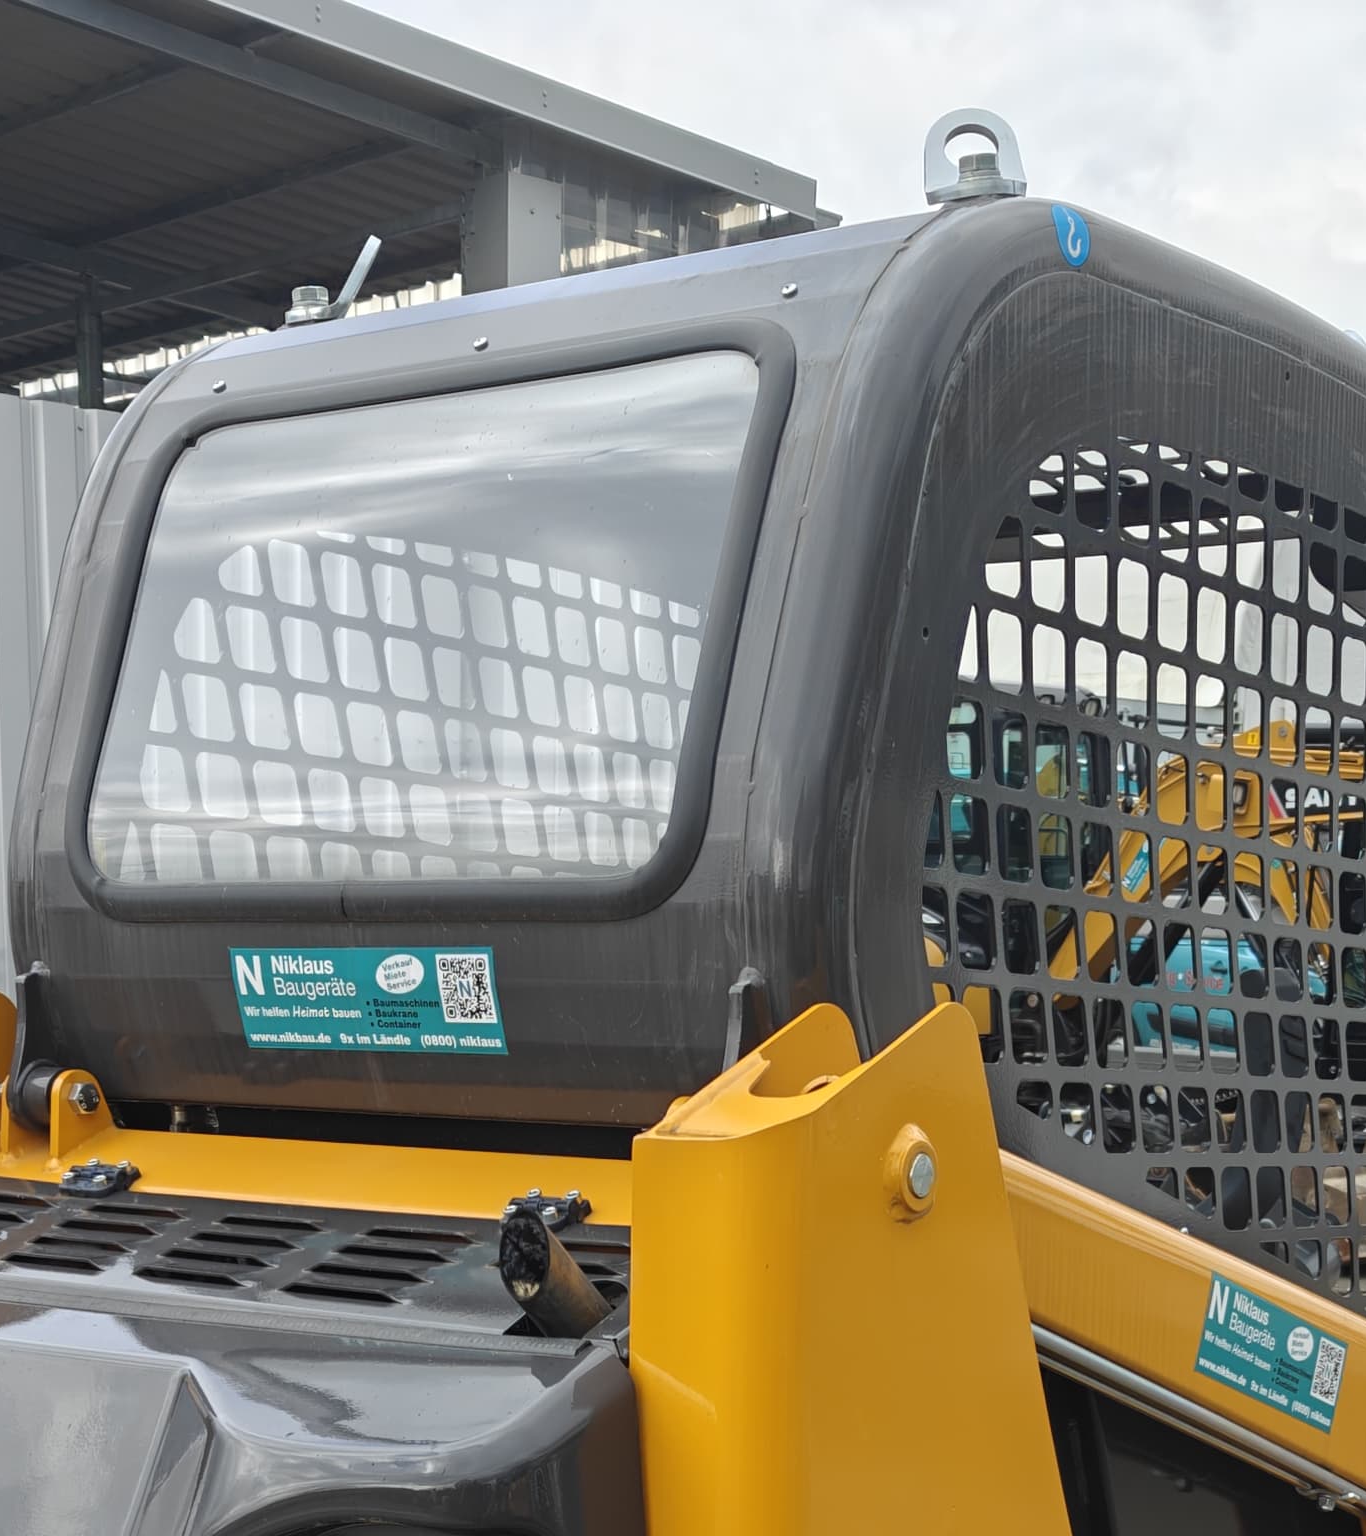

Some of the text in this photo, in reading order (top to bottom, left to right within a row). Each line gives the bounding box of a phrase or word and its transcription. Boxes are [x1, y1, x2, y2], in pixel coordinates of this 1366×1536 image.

[270, 955, 335, 975] Niklaus
[382, 957, 414, 972] Verkauf
[235, 955, 266, 996] N
[383, 971, 407, 981] Miete
[273, 977, 357, 1001] Baugeräte
[386, 978, 417, 991] Service
[373, 998, 441, 1008] Baumaschinen
[244, 1005, 363, 1019] Wir helfen Heimat bauen
[377, 1020, 423, 1029] Container
[250, 1031, 503, 1048] www.nikbau.de 9x im Ländle (0800) niklaus
[1208, 1280, 1230, 1325] N
[1233, 1292, 1270, 1325] Niklaus
[1229, 1312, 1276, 1351] Baugeräte
